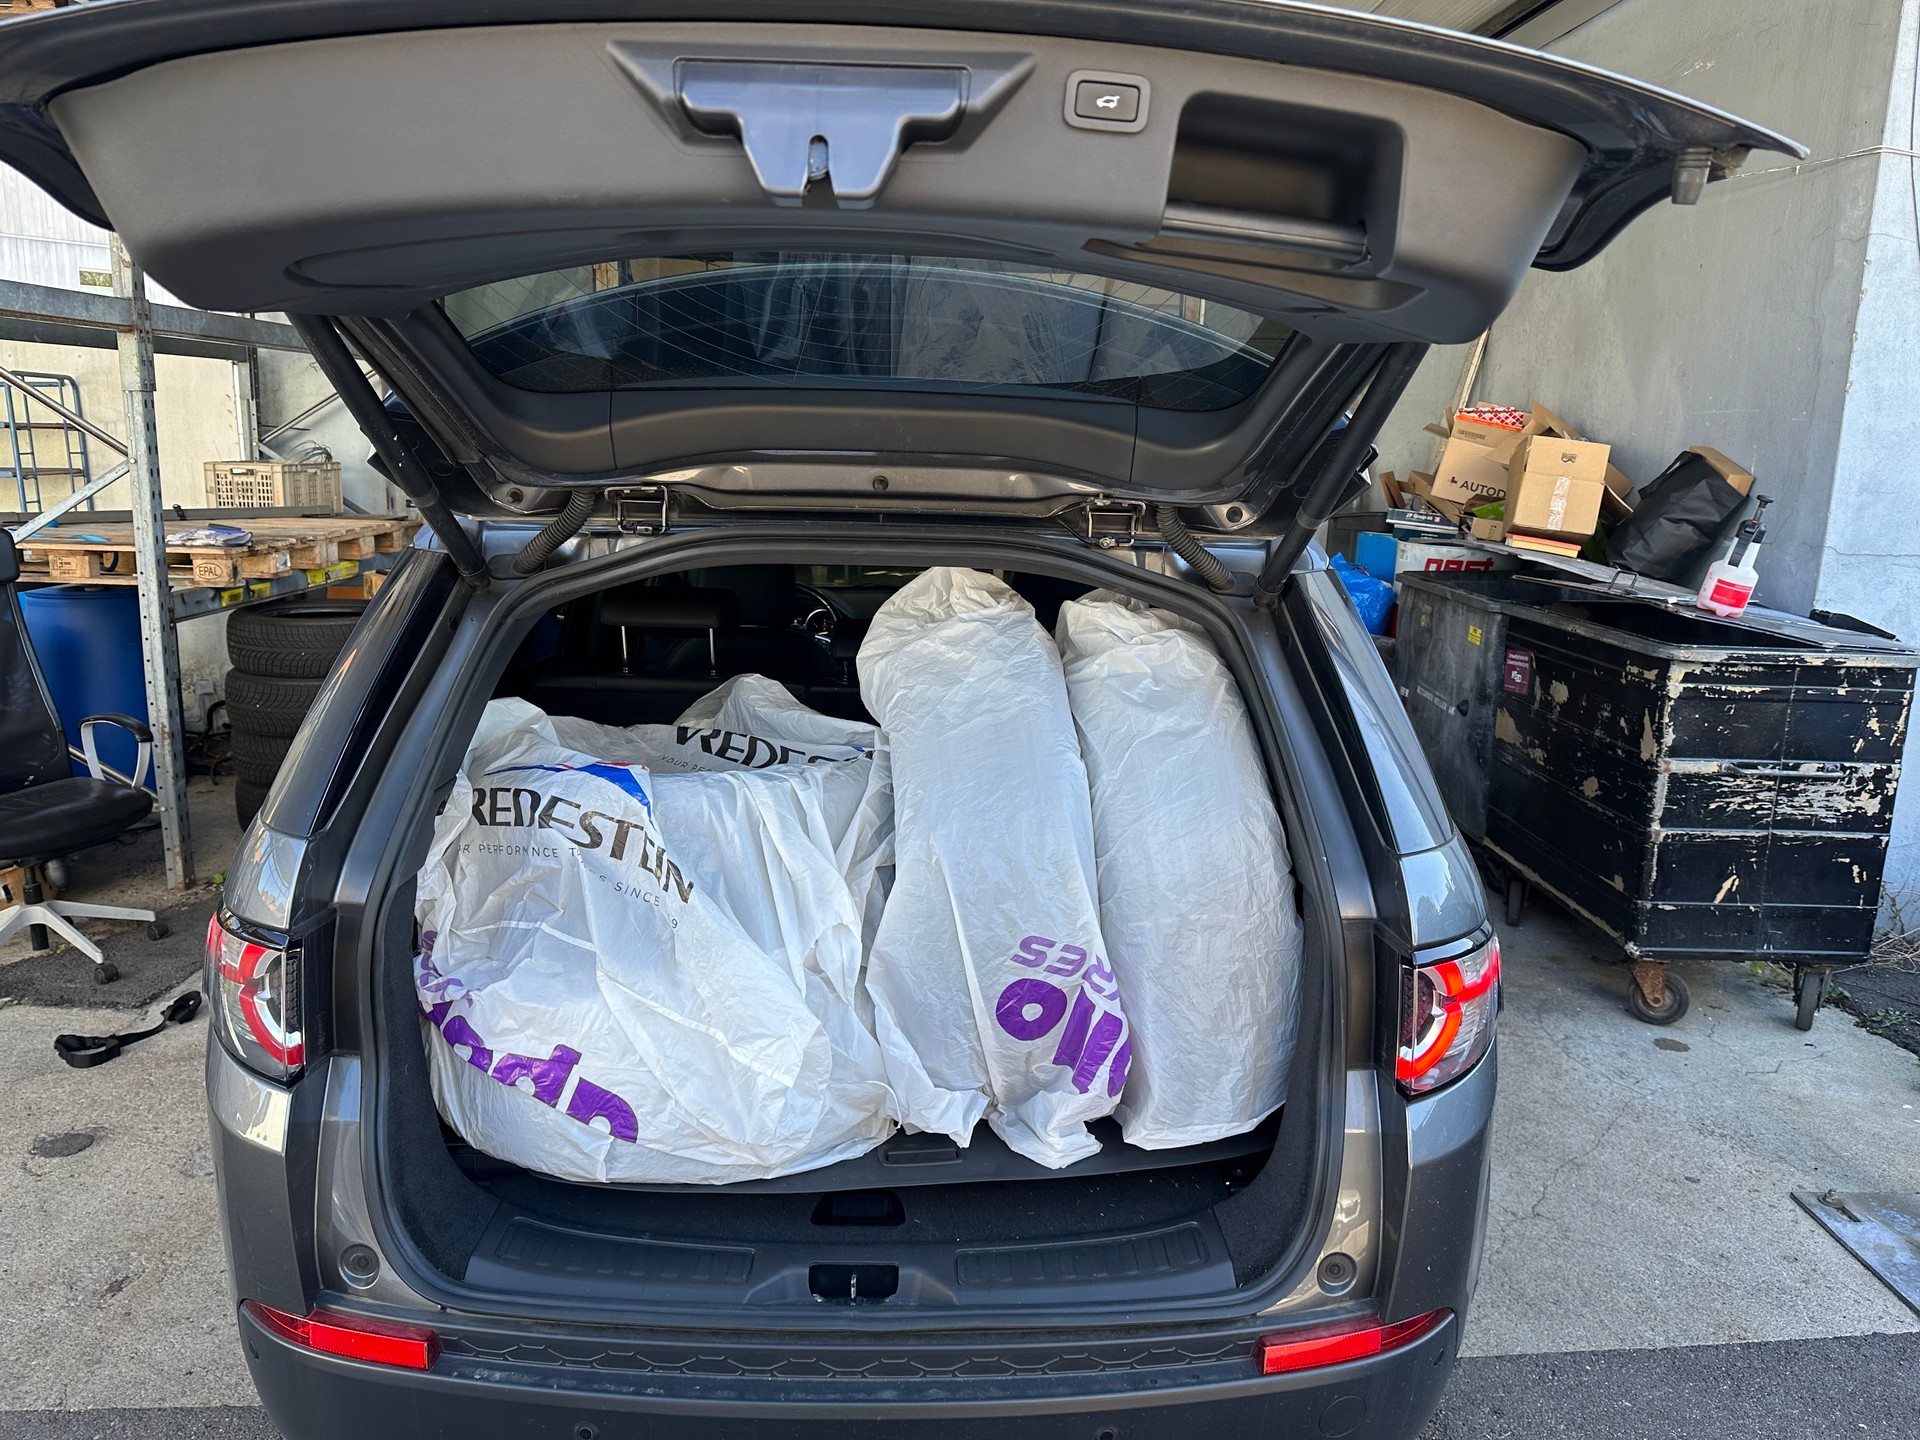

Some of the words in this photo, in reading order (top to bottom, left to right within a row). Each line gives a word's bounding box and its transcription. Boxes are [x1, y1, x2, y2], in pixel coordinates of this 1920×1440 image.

[199, 566, 219, 577] EPAL
[471, 787, 694, 904] REDESTEIN
[614, 881, 660, 906] SINCE
